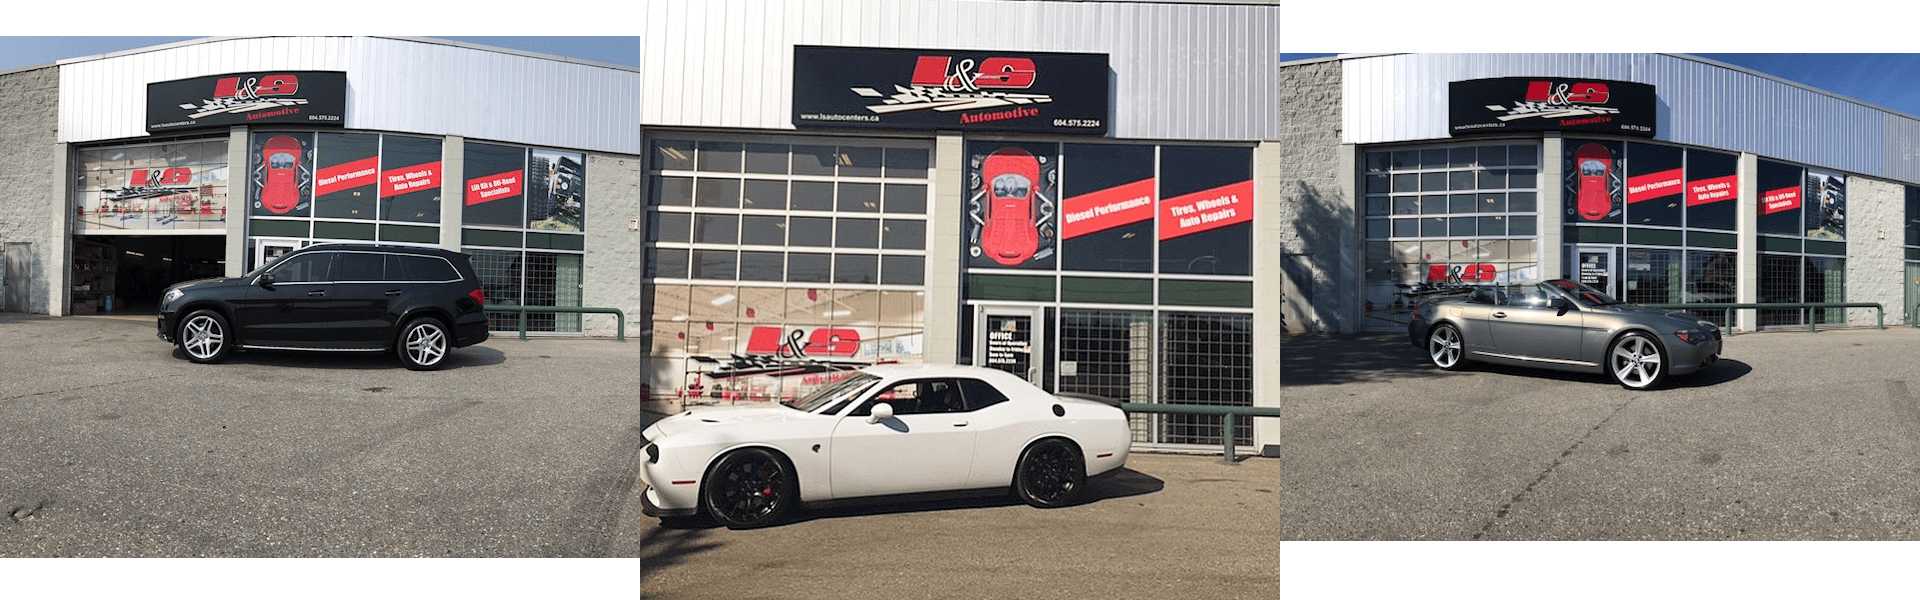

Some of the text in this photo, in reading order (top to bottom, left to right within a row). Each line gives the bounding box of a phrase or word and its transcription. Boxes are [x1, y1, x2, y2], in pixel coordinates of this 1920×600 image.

[246, 107, 300, 121] Automotive
[800, 112, 880, 122] www.lsautocenters.ca
[959, 105, 1040, 126] Automotive
[1559, 115, 1612, 126] Automotive
[1053, 118, 1101, 128] 604.575.2224
[317, 167, 376, 187] Diesel Performance
[405, 170, 428, 180] Wheels
[394, 178, 431, 191] Auto Repairs
[1628, 178, 1681, 194] Diesel Performance
[1707, 182, 1727, 191] Wheels
[480, 186, 511, 198] Specialists
[1065, 195, 1151, 224] Diesel Performance
[1169, 195, 1239, 217] Tires, Wheels &
[1179, 208, 1237, 229] Auto Repairs
[989, 331, 1013, 340] OFFICE
